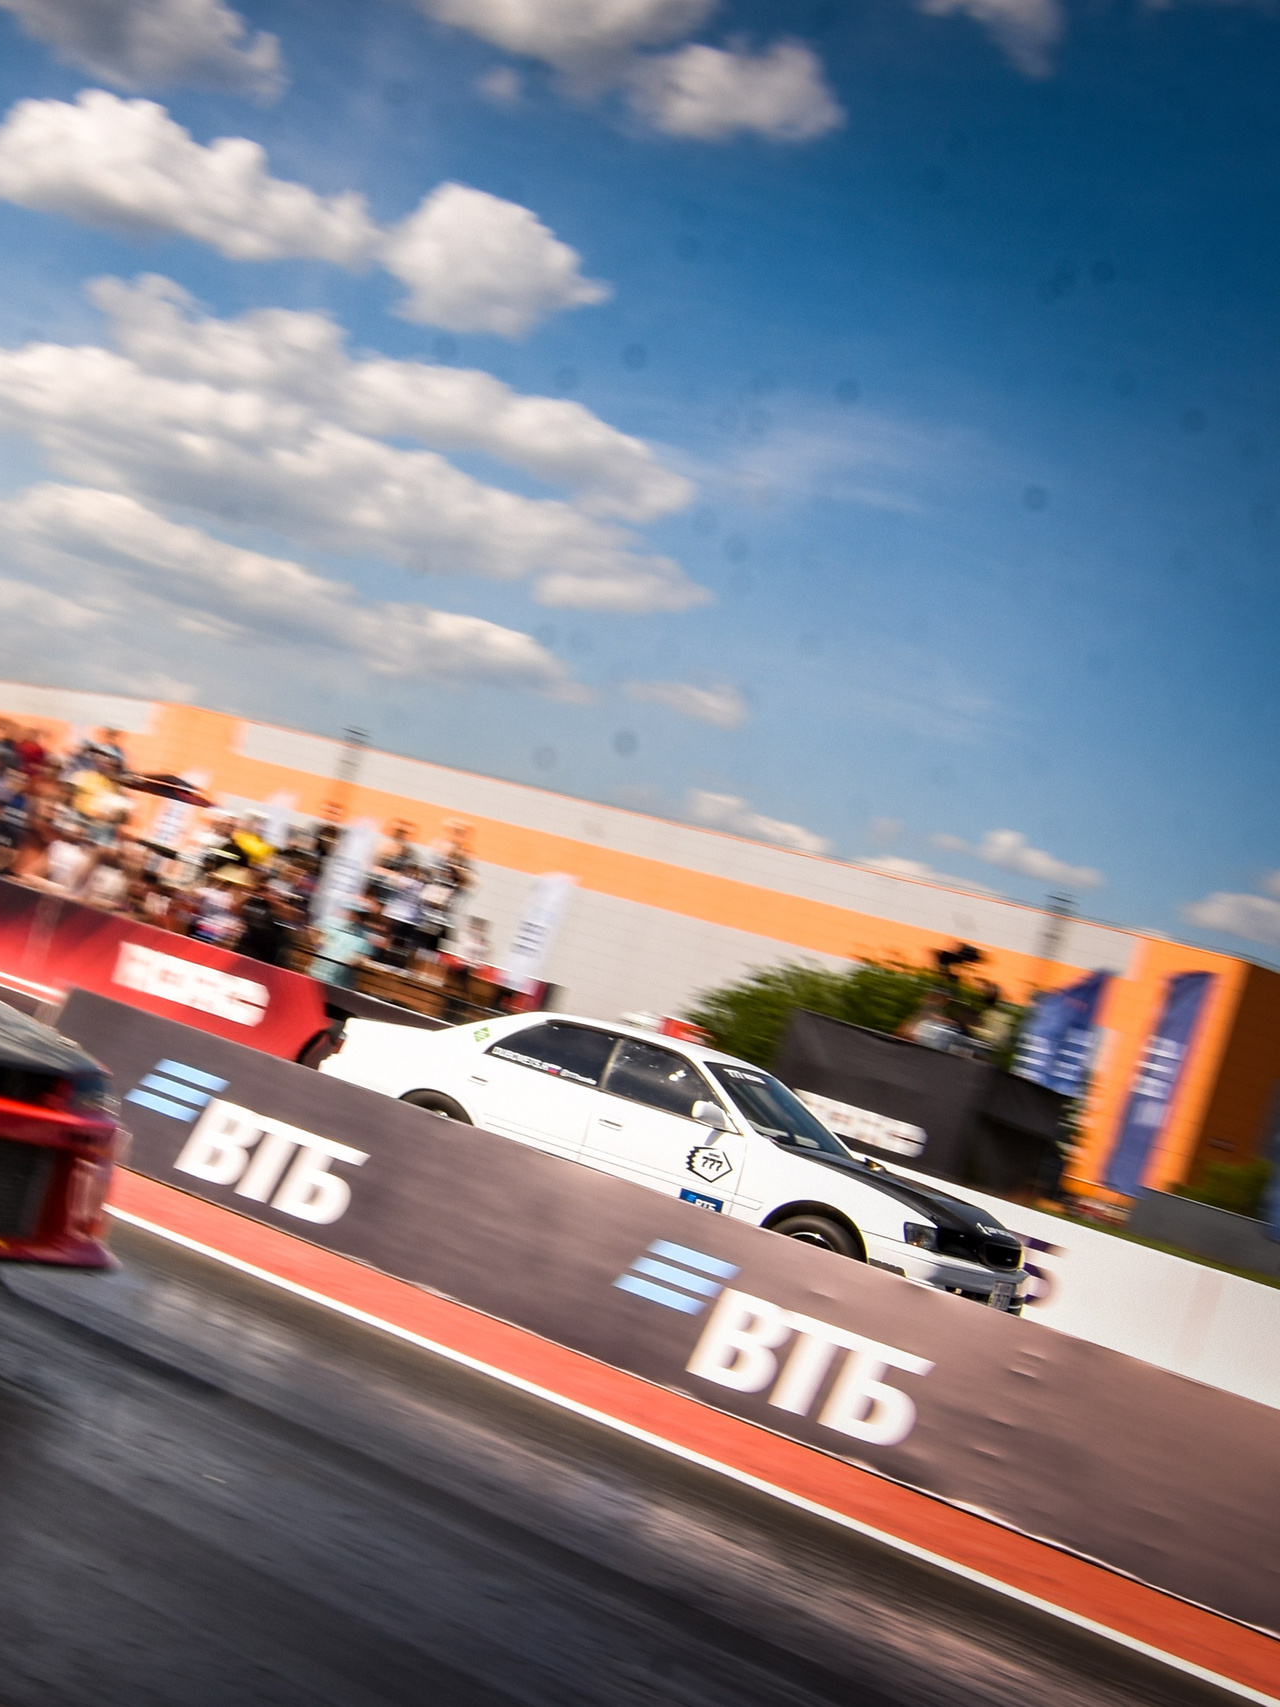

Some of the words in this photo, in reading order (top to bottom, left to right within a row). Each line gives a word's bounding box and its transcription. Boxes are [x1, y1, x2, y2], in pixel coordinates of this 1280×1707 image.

[173, 1097, 371, 1226] ВТБ
[701, 1156, 724, 1172] 777
[685, 1287, 937, 1447] ВТБ
